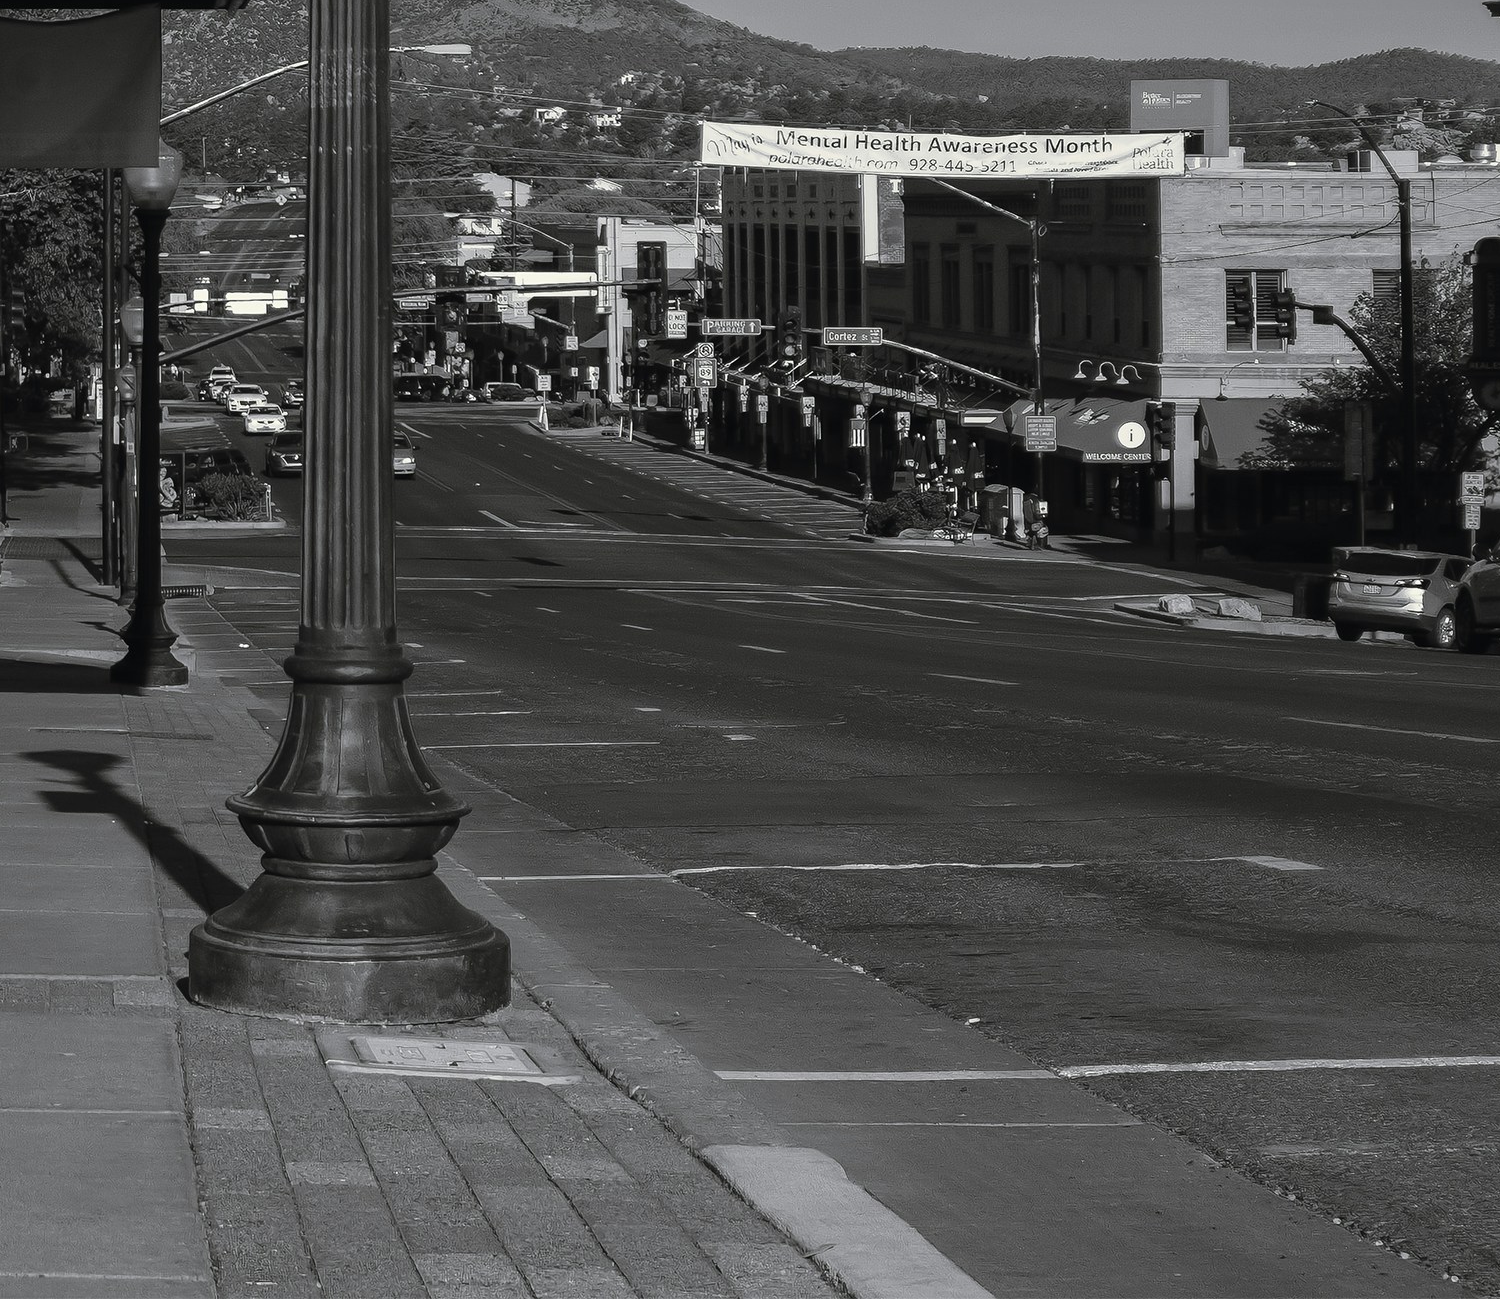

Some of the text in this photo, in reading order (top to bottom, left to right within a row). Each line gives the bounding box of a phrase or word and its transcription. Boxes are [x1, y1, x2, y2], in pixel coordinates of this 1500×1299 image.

[776, 130, 847, 149] Mental
[856, 134, 921, 153] Health
[928, 137, 1037, 154] Awareness
[1045, 137, 1113, 154] Month
[909, 158, 1018, 173] 928-445-5211
[829, 331, 857, 341] Cortez
